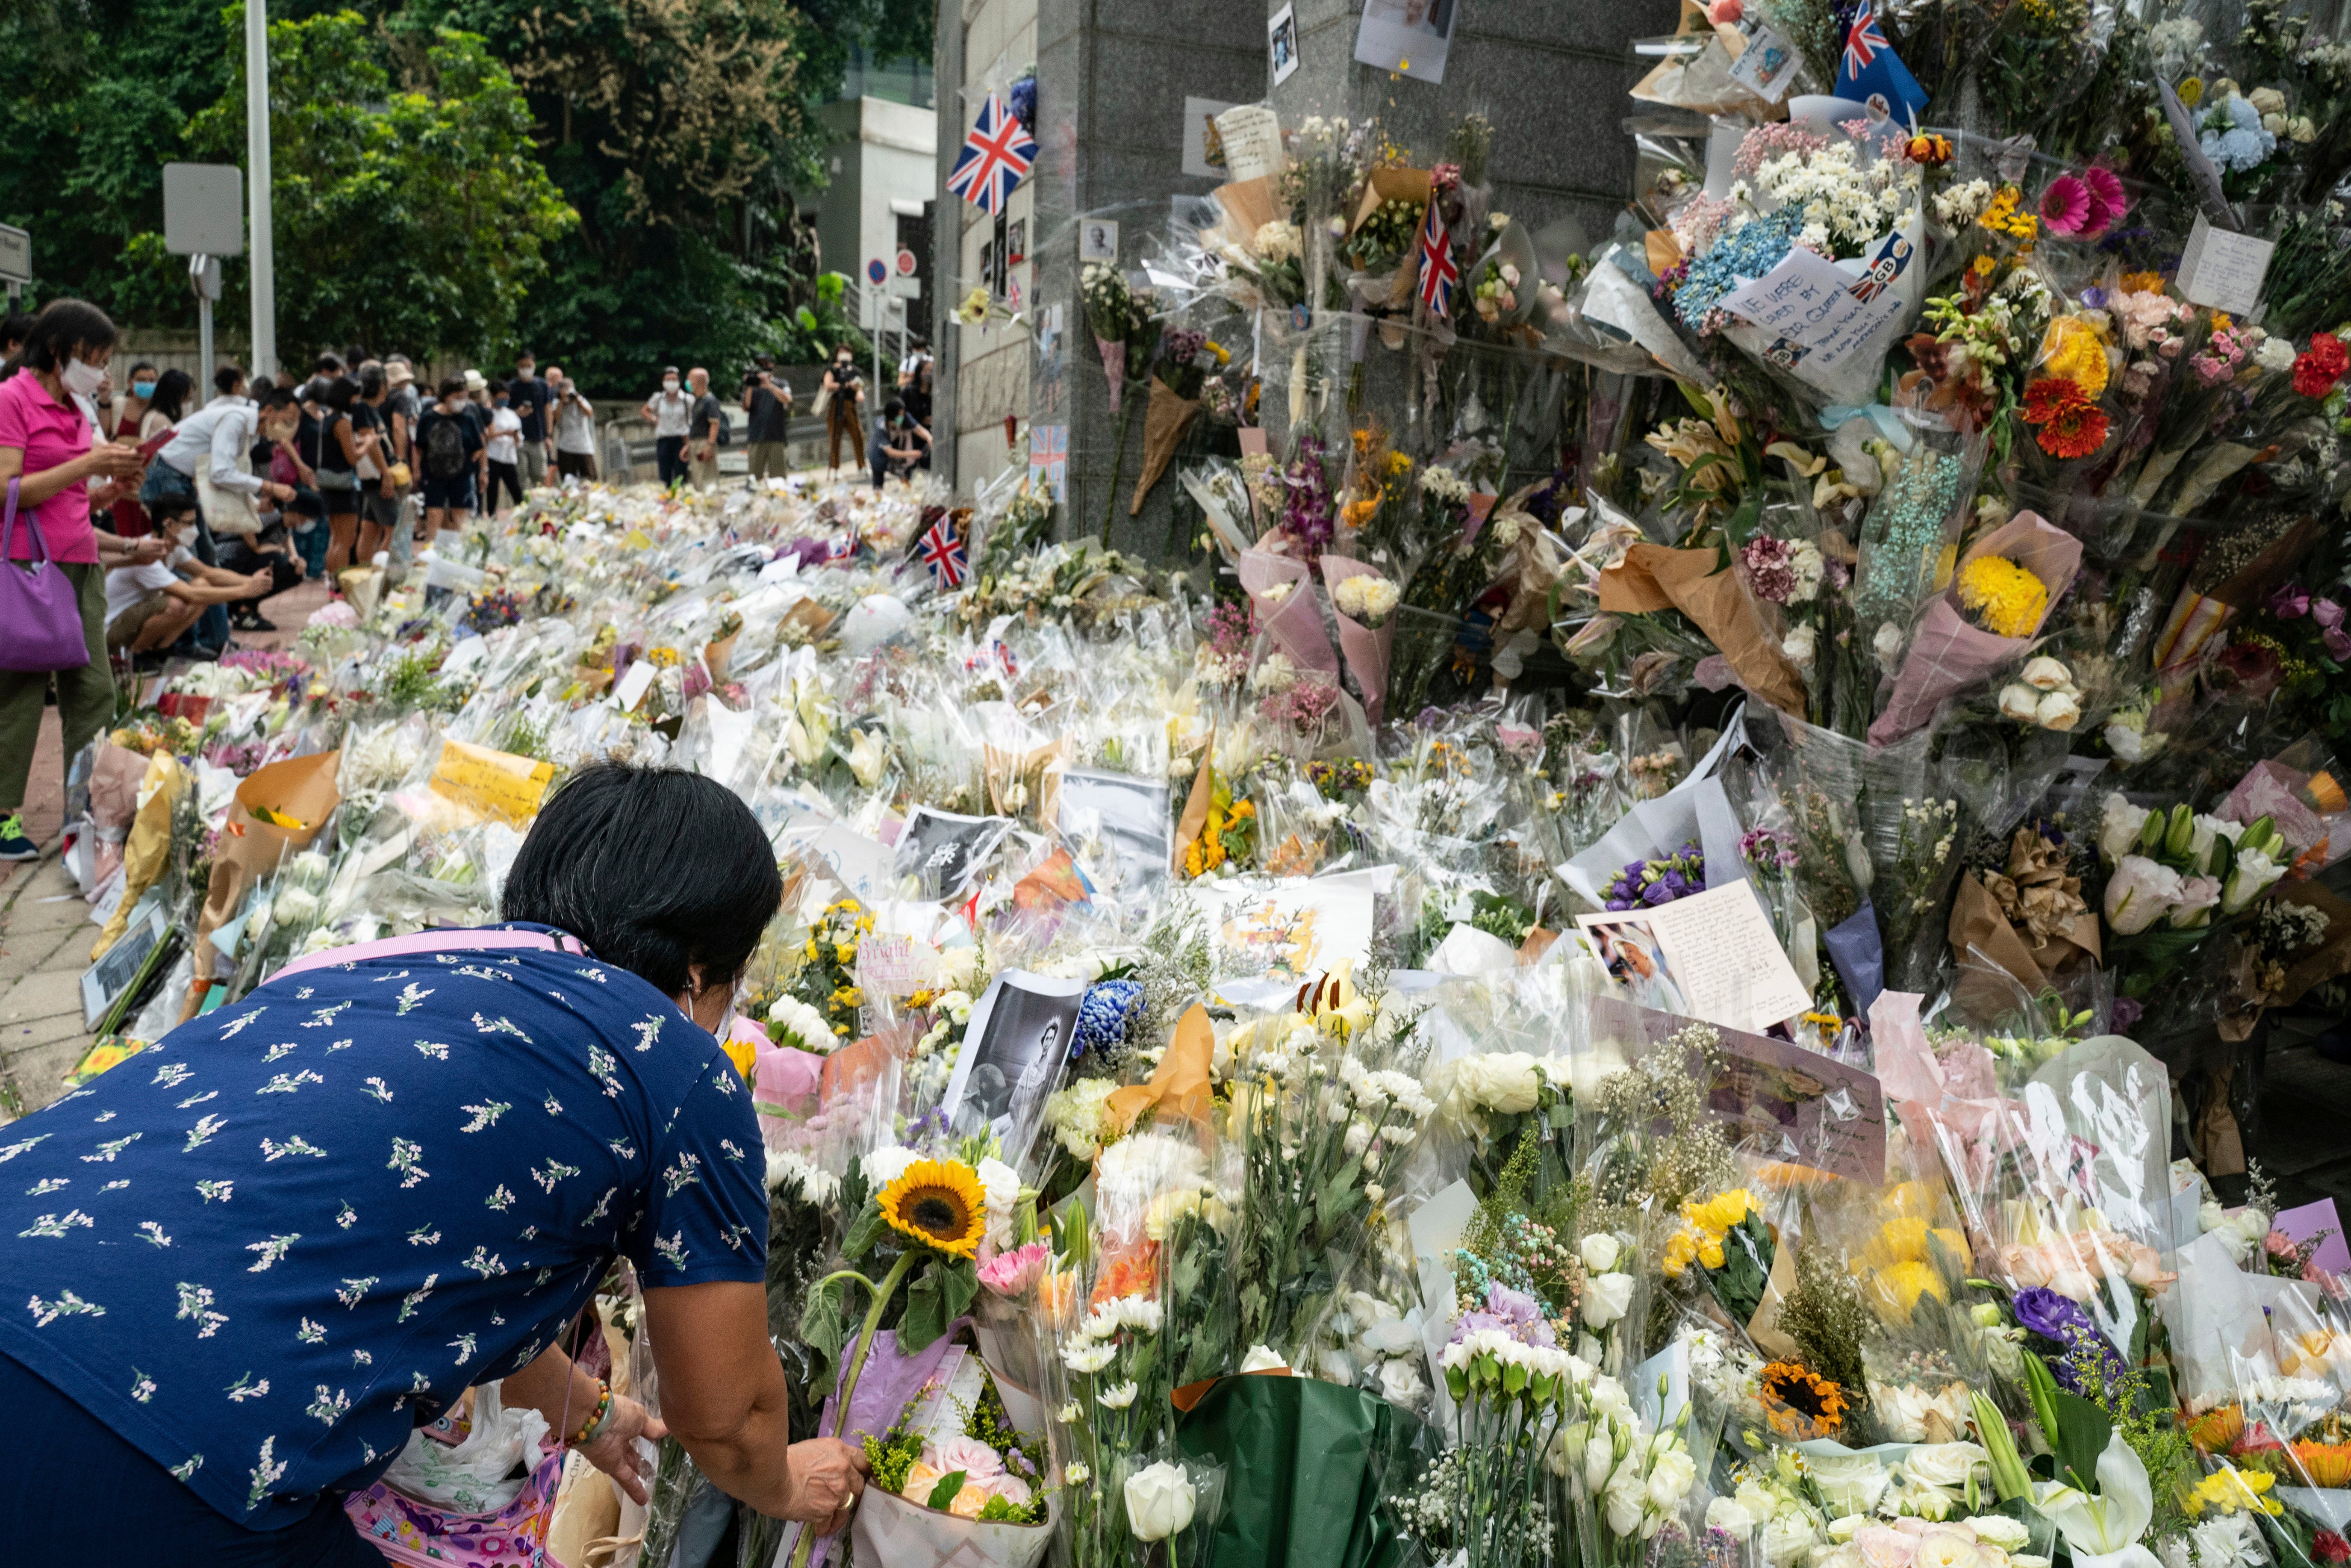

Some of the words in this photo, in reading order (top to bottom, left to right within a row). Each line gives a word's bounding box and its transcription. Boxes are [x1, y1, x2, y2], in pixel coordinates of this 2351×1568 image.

[1875, 259, 1894, 281] GB
[1766, 275, 1803, 302] WERE
[1800, 284, 1820, 301] BY
[1806, 282, 1853, 323] QUEEN
